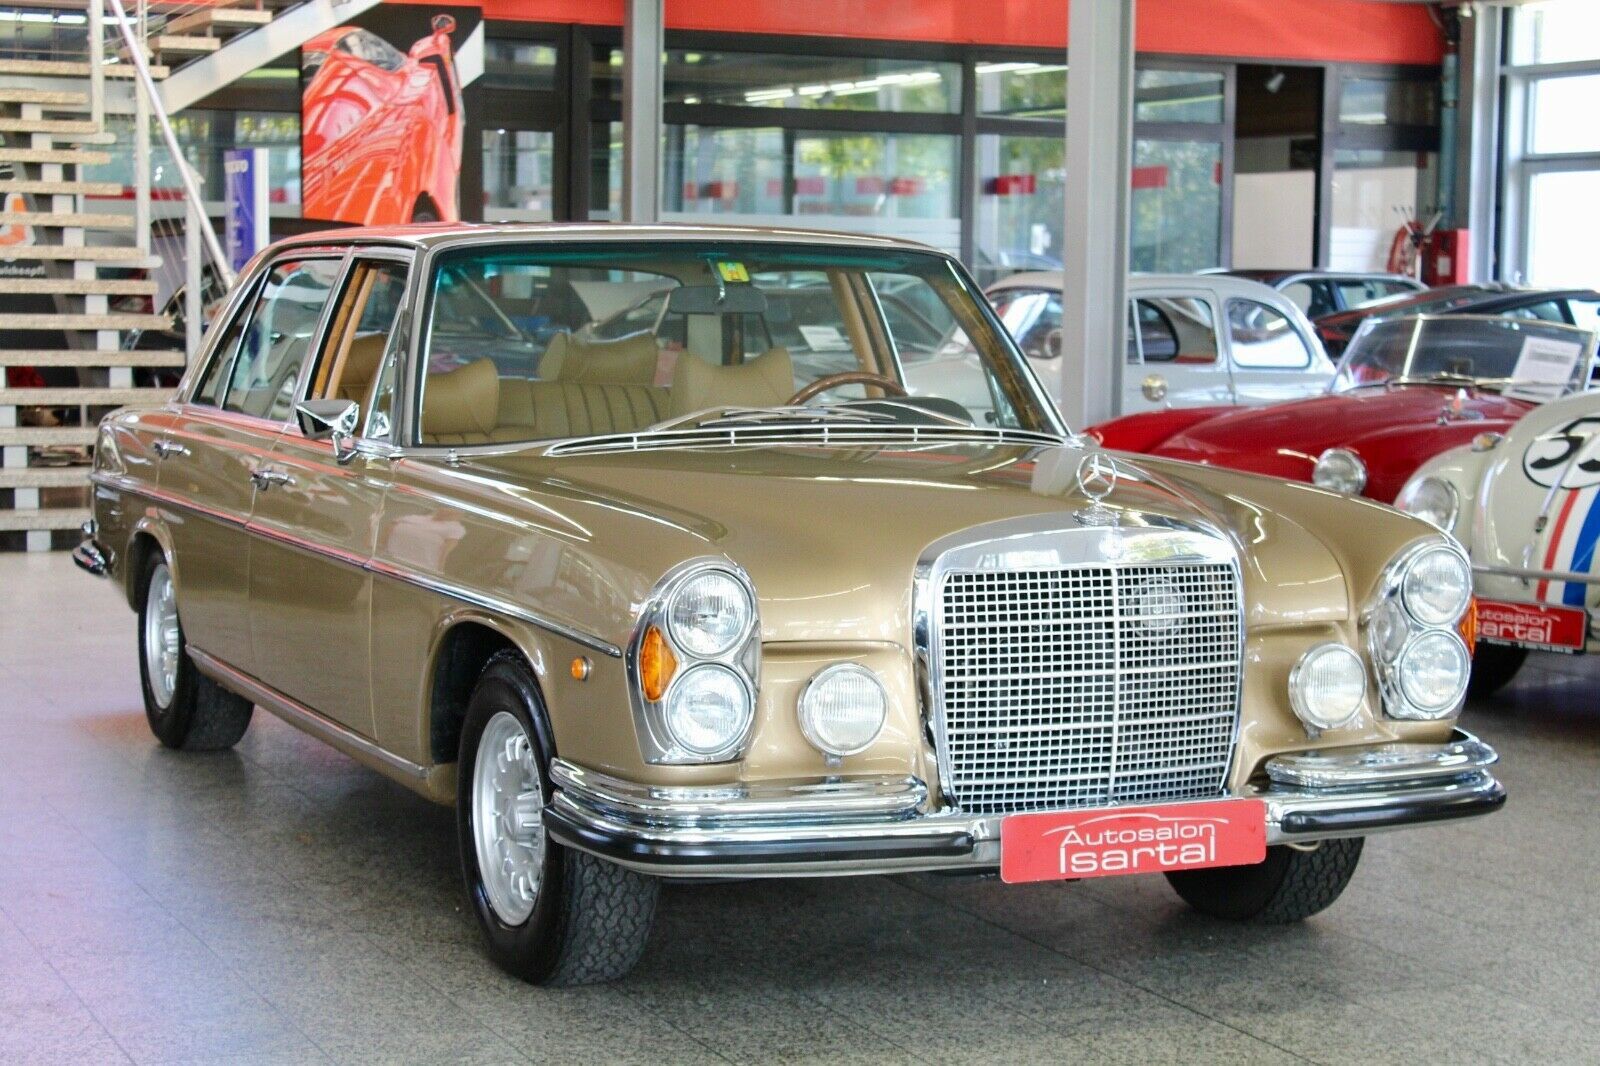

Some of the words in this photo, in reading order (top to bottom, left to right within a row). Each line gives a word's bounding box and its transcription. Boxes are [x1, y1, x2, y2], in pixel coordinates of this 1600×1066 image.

[1476, 609, 1552, 627] utosalon
[1476, 620, 1552, 643] artal
[1061, 822, 1215, 848] Autosalon
[1059, 836, 1216, 874] Isartal
